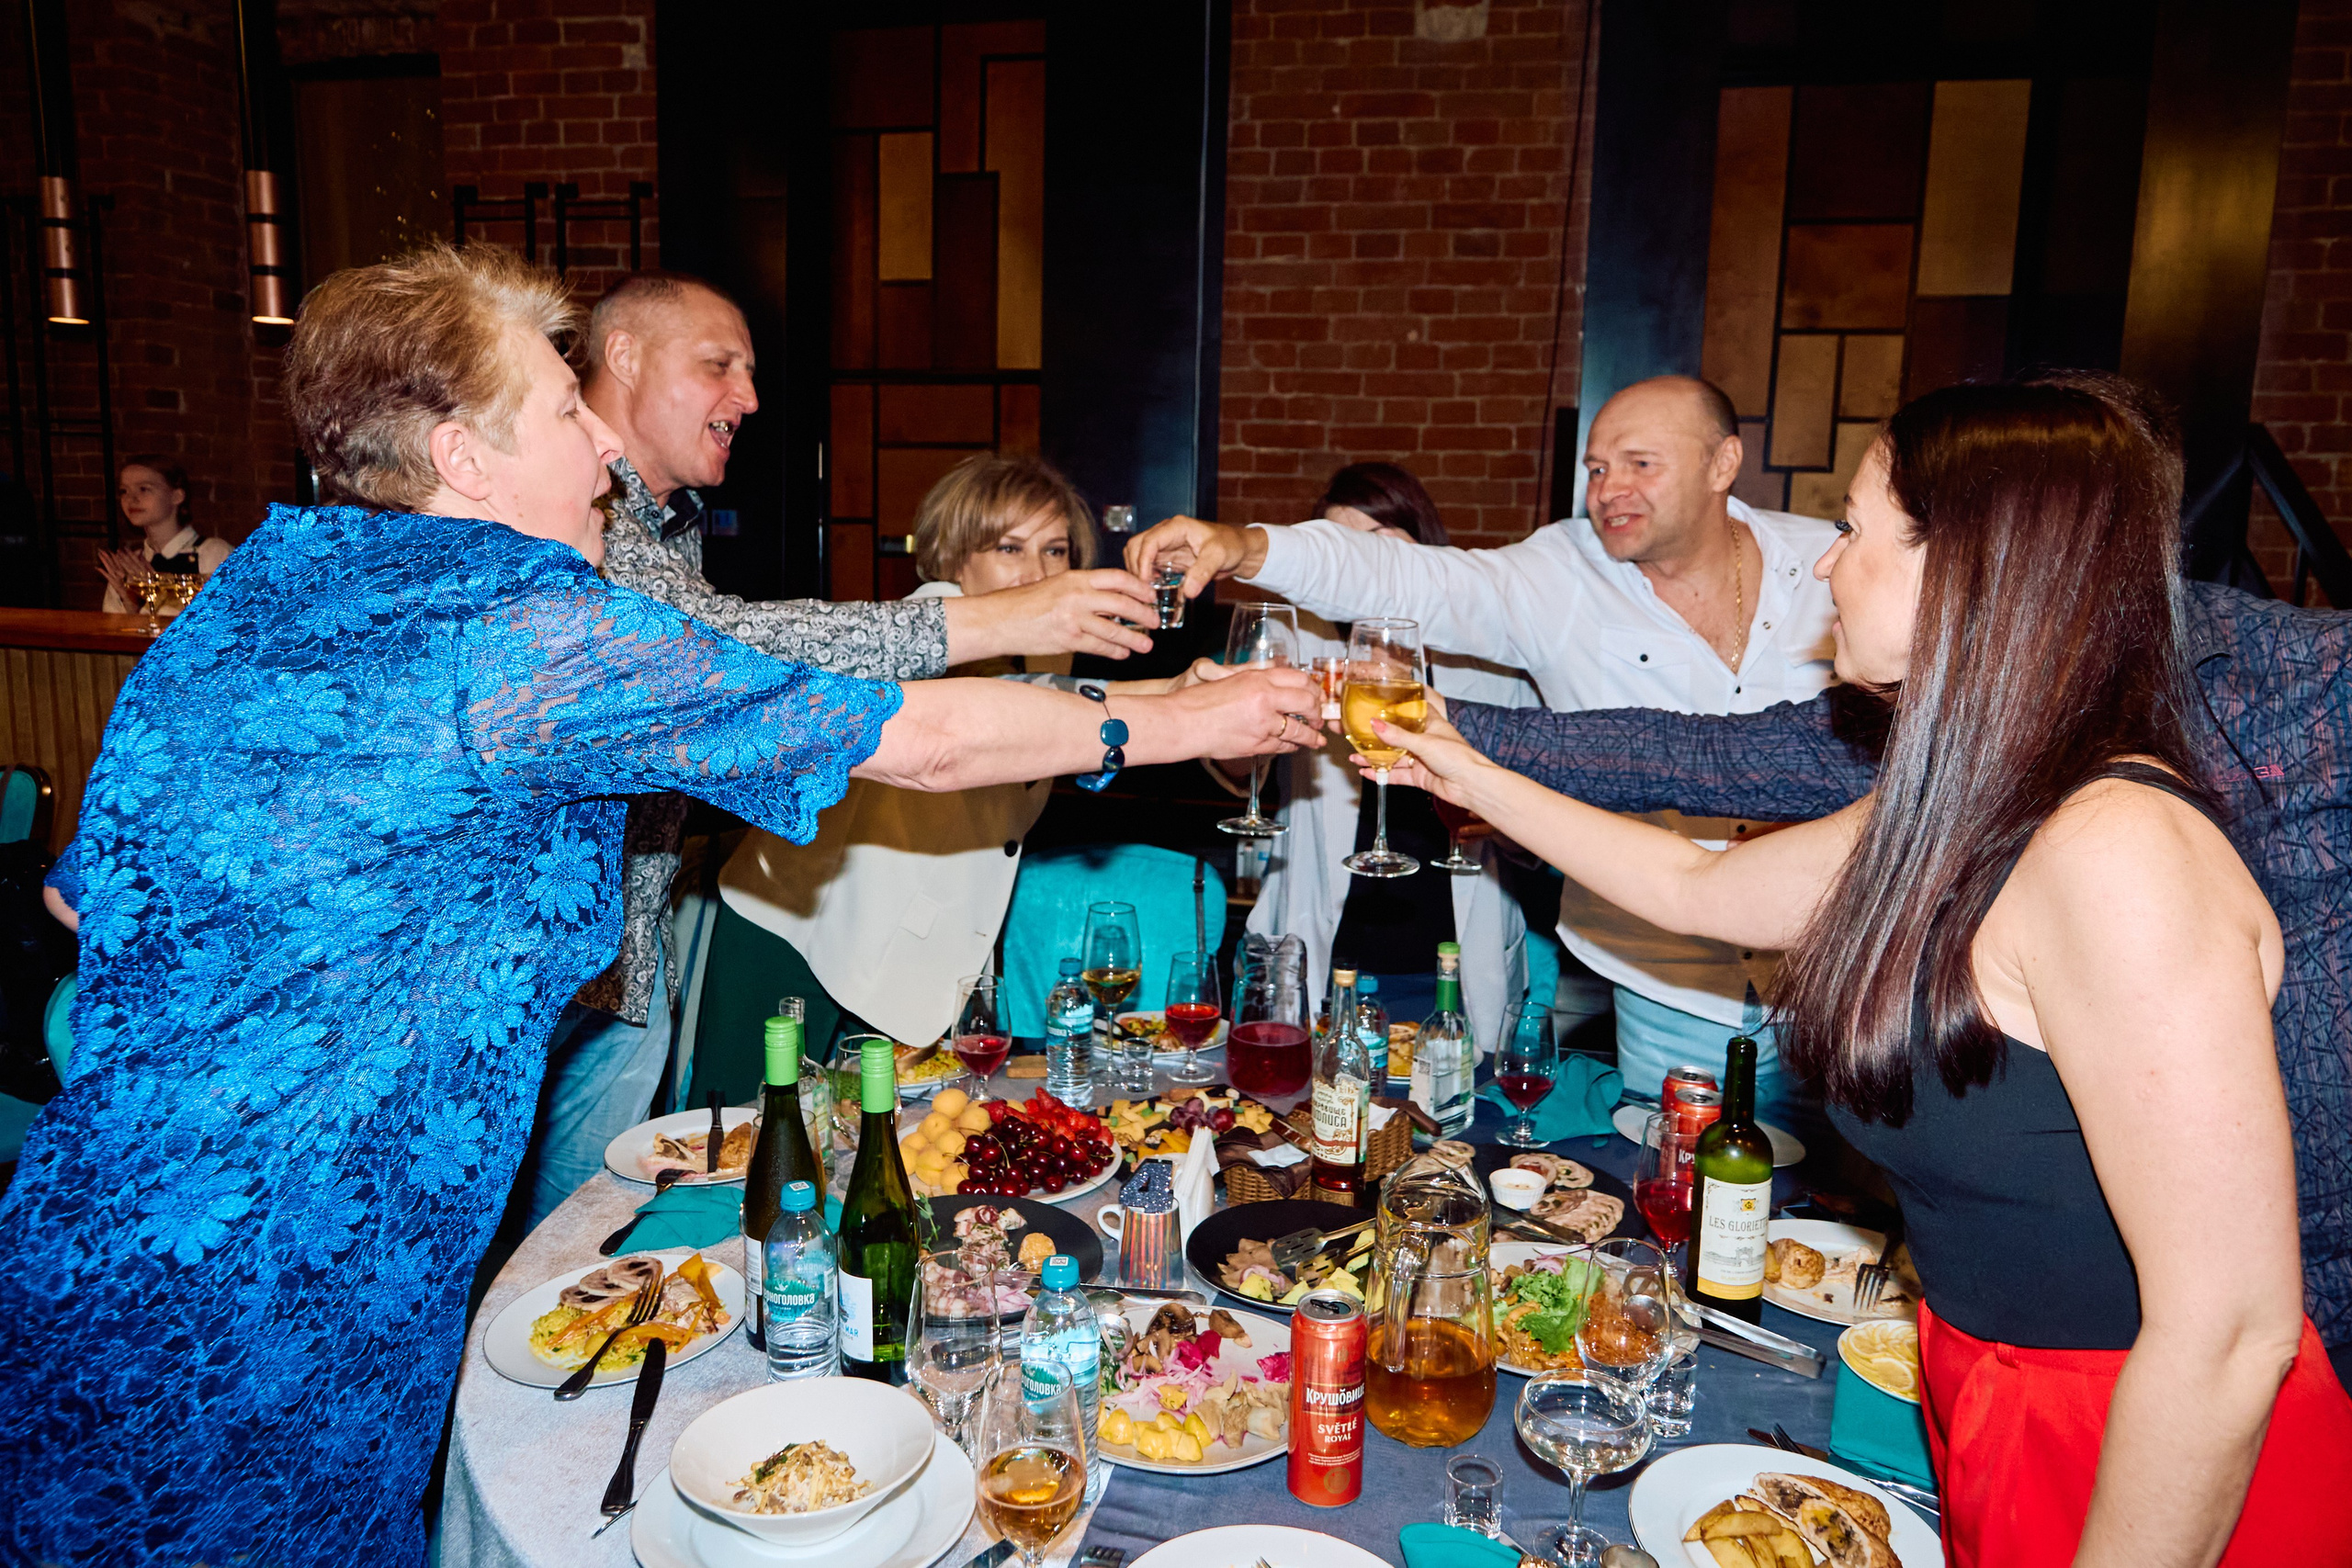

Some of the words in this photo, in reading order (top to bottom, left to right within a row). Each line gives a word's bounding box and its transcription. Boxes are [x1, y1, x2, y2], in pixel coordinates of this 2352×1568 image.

[1119, 1158, 1174, 1213] 4
[1709, 1215, 1725, 1230] LES
[845, 1325, 859, 1337] MAR
[1023, 1377, 1061, 1396] головка
[1317, 1416, 1357, 1434] SVĚTLÉ
[1325, 1433, 1351, 1443] ROYAL
